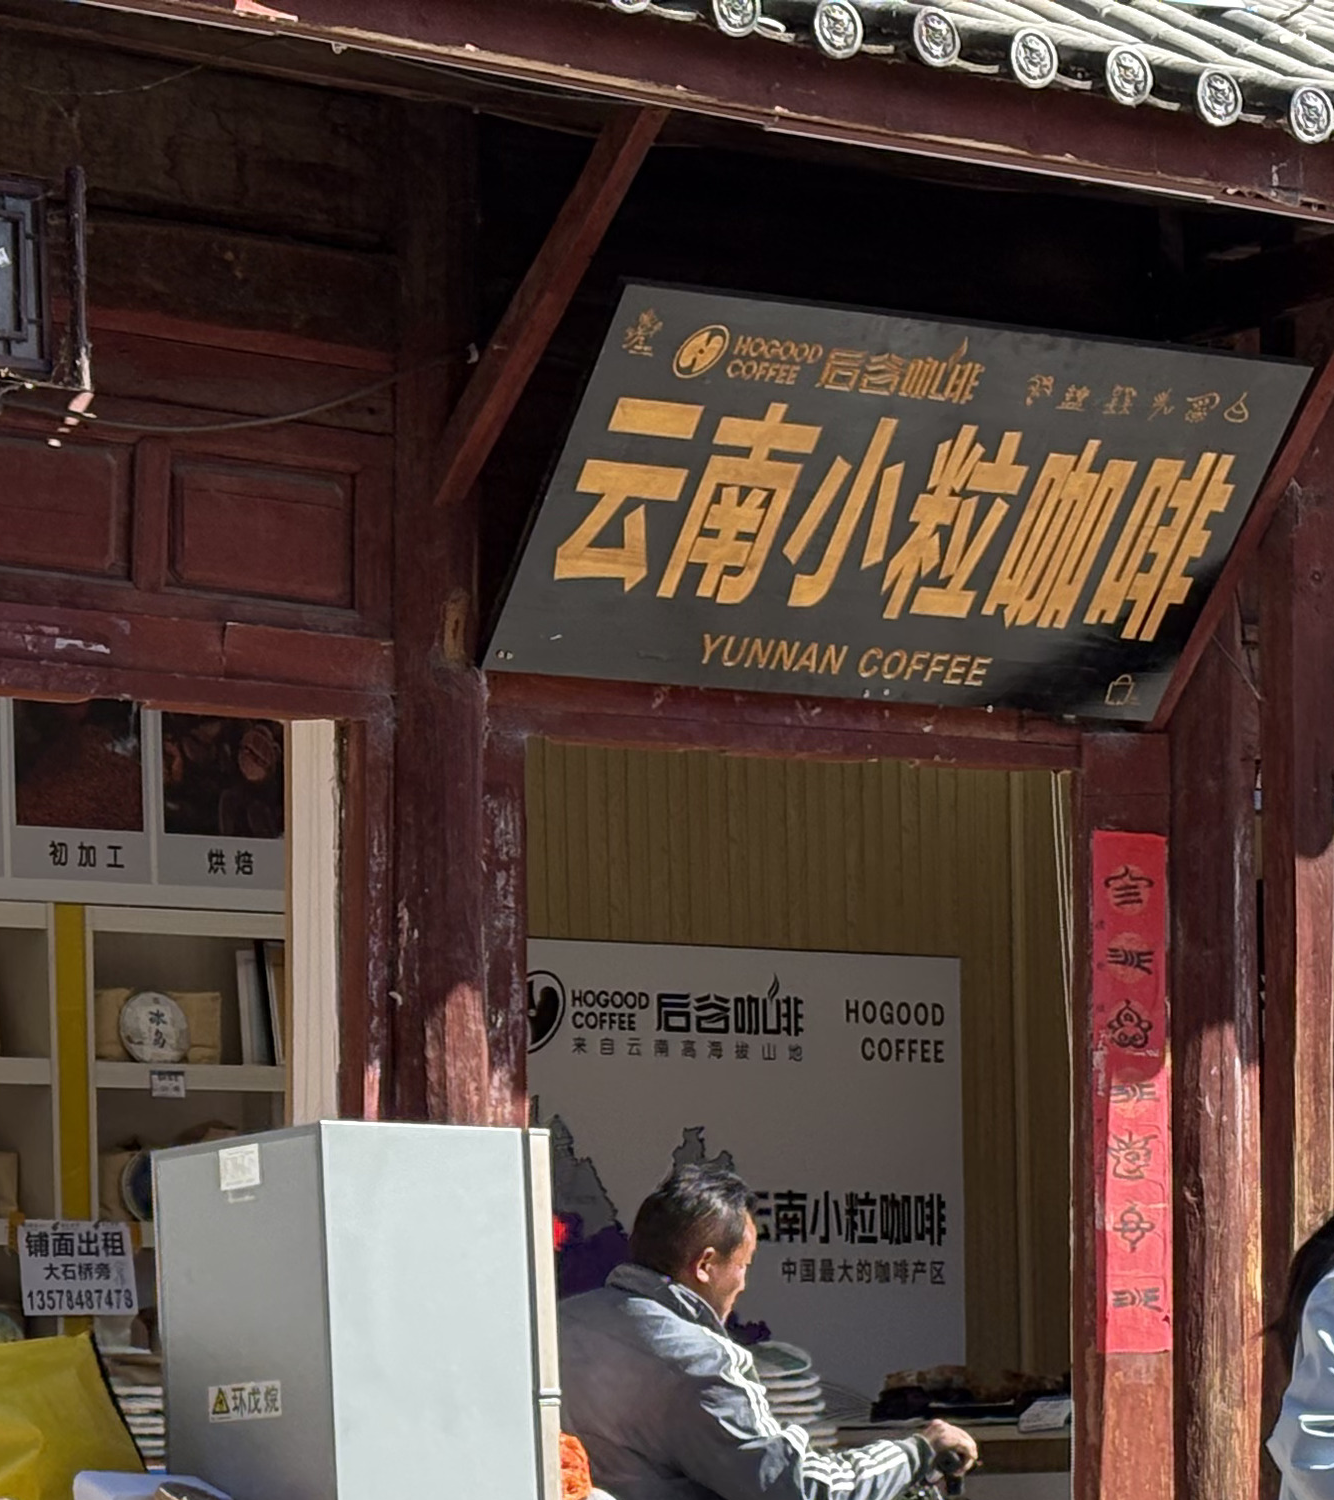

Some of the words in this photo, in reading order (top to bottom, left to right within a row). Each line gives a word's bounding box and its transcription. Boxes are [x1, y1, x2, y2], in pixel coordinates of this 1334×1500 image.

[733, 335, 823, 365] HOGOOD
[725, 359, 802, 386] COFFEE
[816, 341, 985, 404] 后谷咖啡
[553, 397, 1236, 642] 云南小粒咖啡
[699, 633, 850, 677] YUNNAN
[857, 646, 993, 687] COFFEE
[49, 840, 126, 870] 初加工
[207, 848, 255, 877] 烘焙
[571, 989, 650, 1010] HOGOOD
[655, 980, 804, 1037] 后谷咖啡
[844, 999, 946, 1028] HOGOOD
[571, 1010, 637, 1032] COFFEE
[571, 1036, 804, 1062] 来自云南高海拔山地
[861, 1037, 946, 1064] COFFEE
[25, 1231, 126, 1258] 铺面出租
[43, 1262, 112, 1281] 大石桥旁
[781, 1257, 946, 1285] 中国最大的咖啡产区
